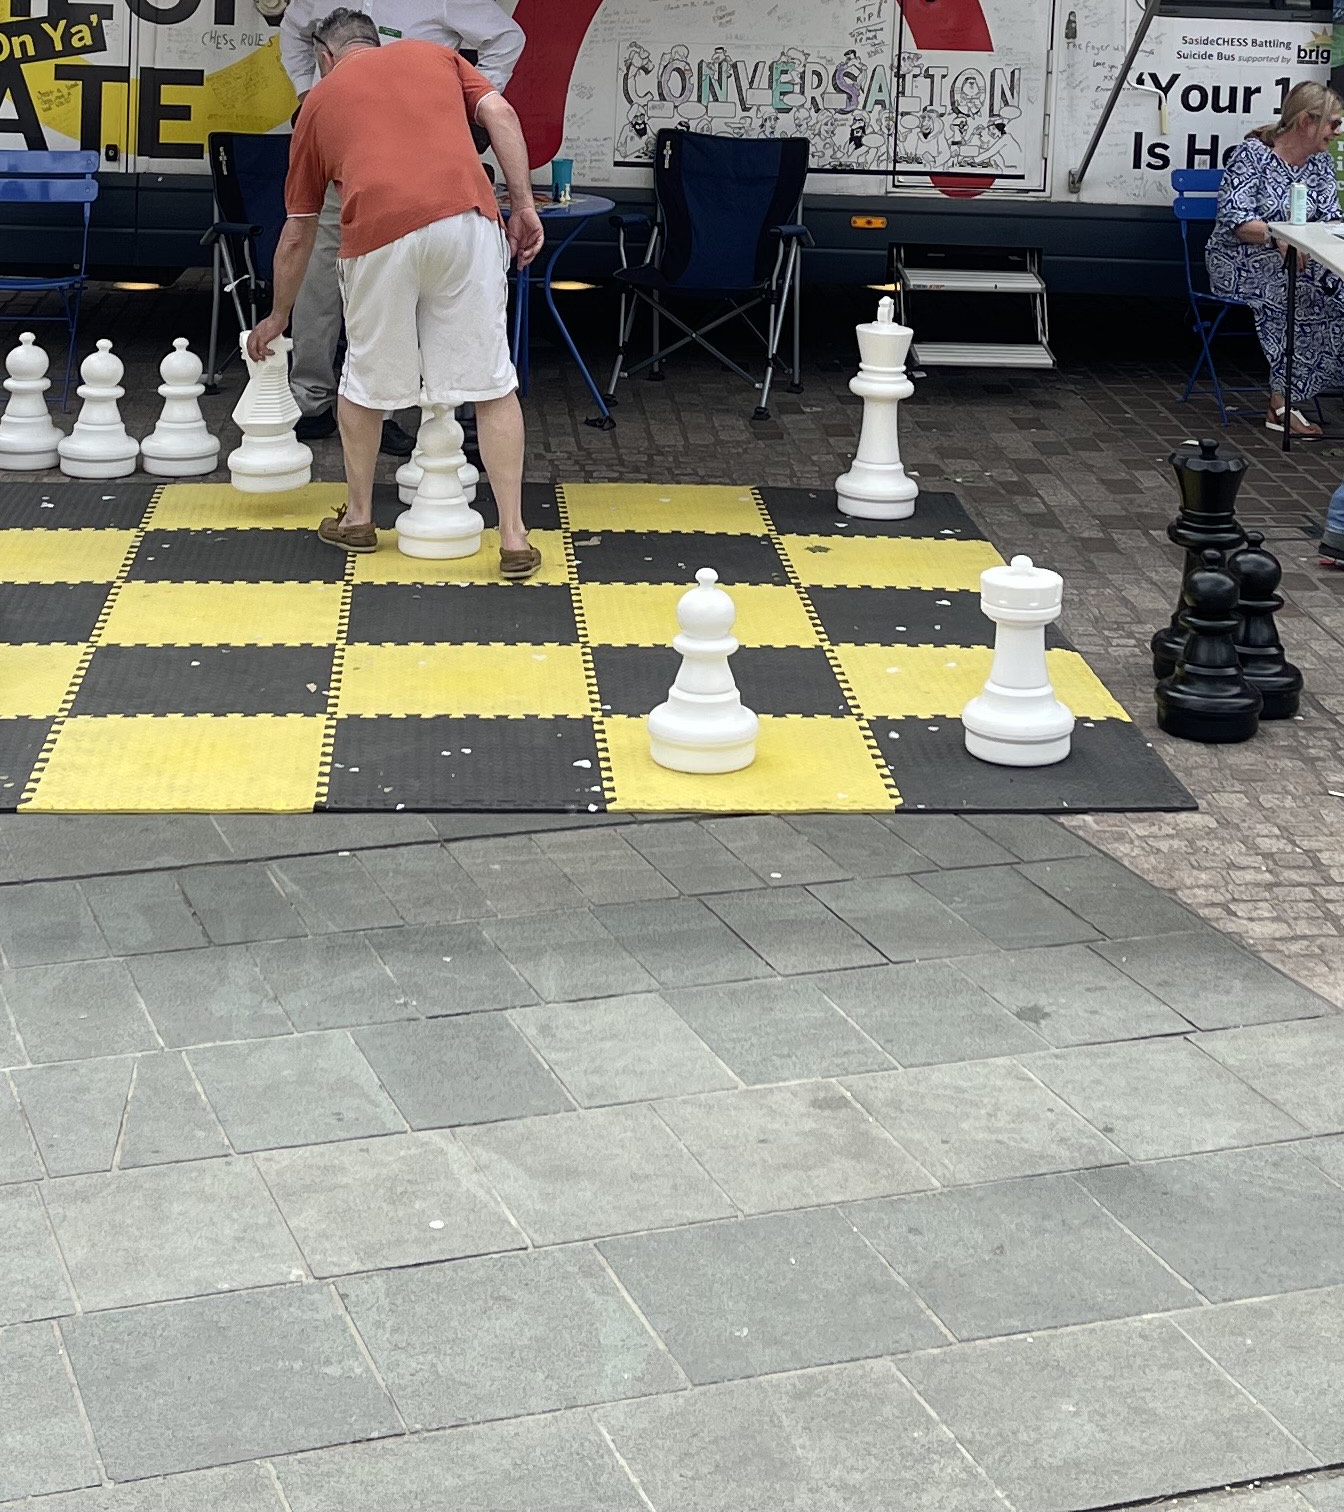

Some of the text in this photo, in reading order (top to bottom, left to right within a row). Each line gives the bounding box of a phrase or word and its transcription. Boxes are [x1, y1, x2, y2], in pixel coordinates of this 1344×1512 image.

[202, 30, 274, 50] CHESS RULES
[1251, 38, 1292, 50] Battling
[1176, 49, 1292, 65] Suicide Bus supported by
[1297, 44, 1331, 64] brig
[624, 59, 1021, 118] CONVERSATION
[1132, 131, 1171, 171] Is
